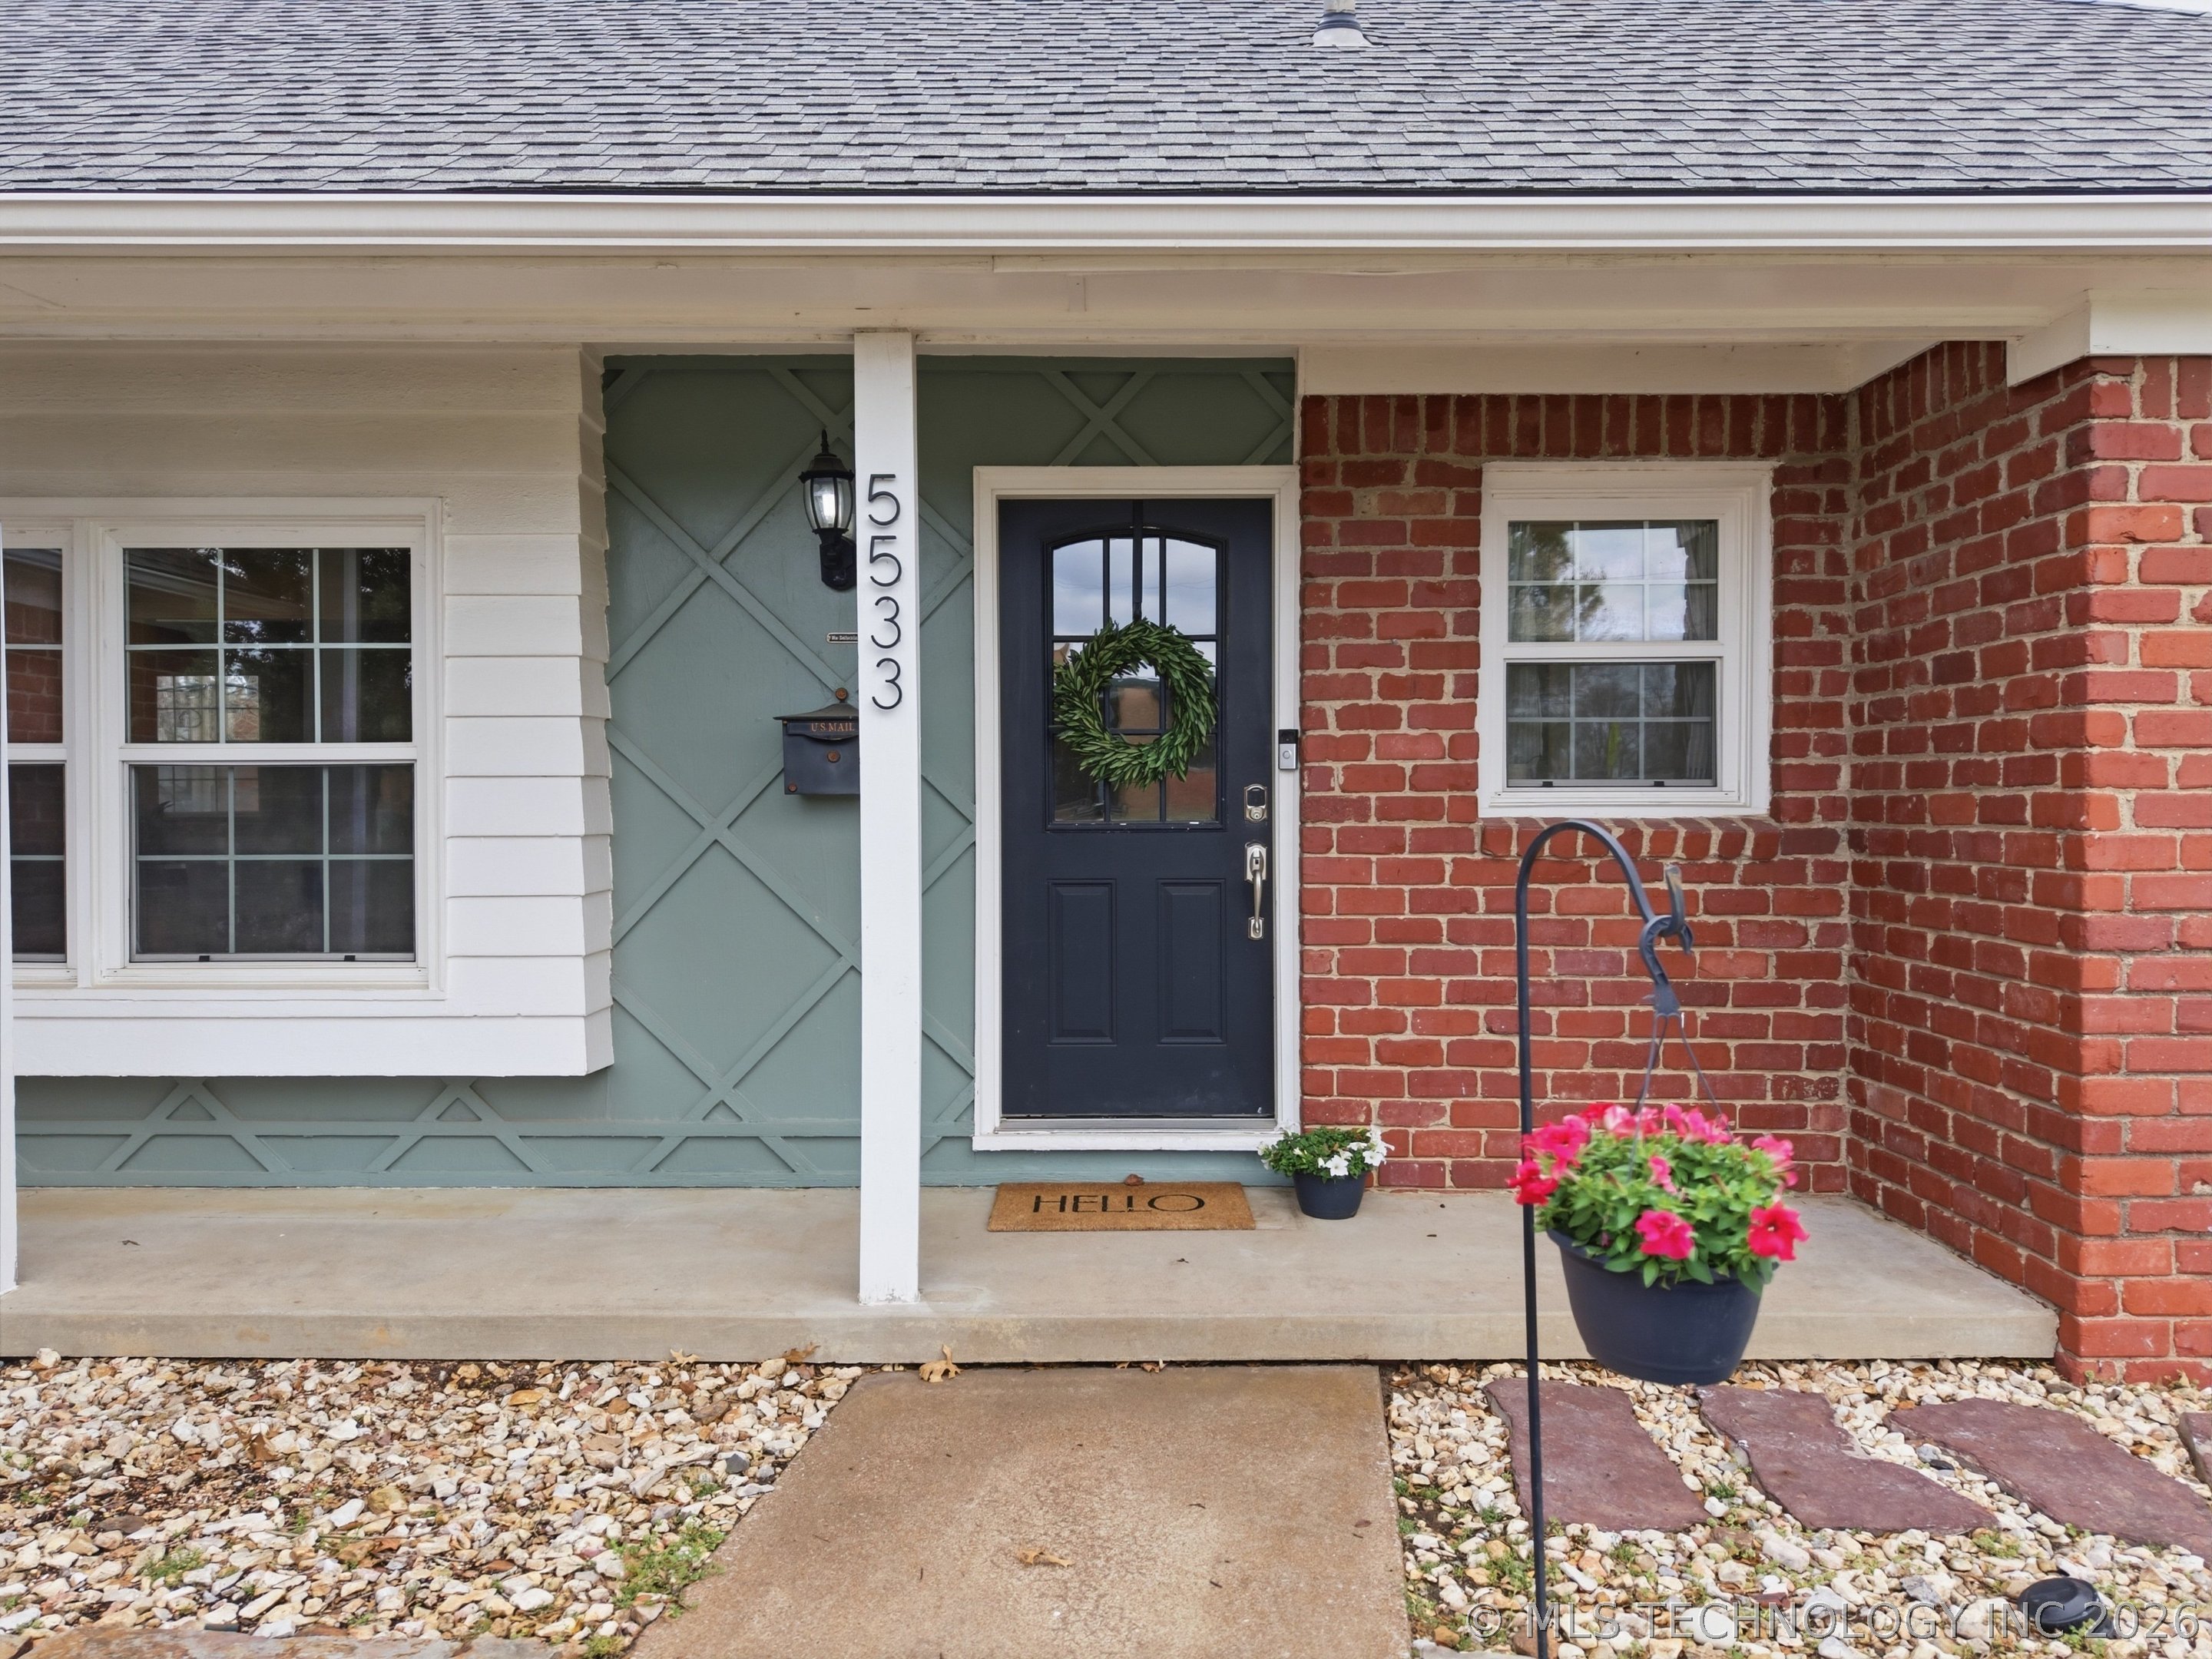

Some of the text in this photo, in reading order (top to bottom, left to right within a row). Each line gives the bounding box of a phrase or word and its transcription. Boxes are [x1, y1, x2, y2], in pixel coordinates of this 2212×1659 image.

[868, 474, 902, 710] 5533
[829, 722, 855, 732] MAIL
[1032, 1194, 1205, 1213] HELLO
